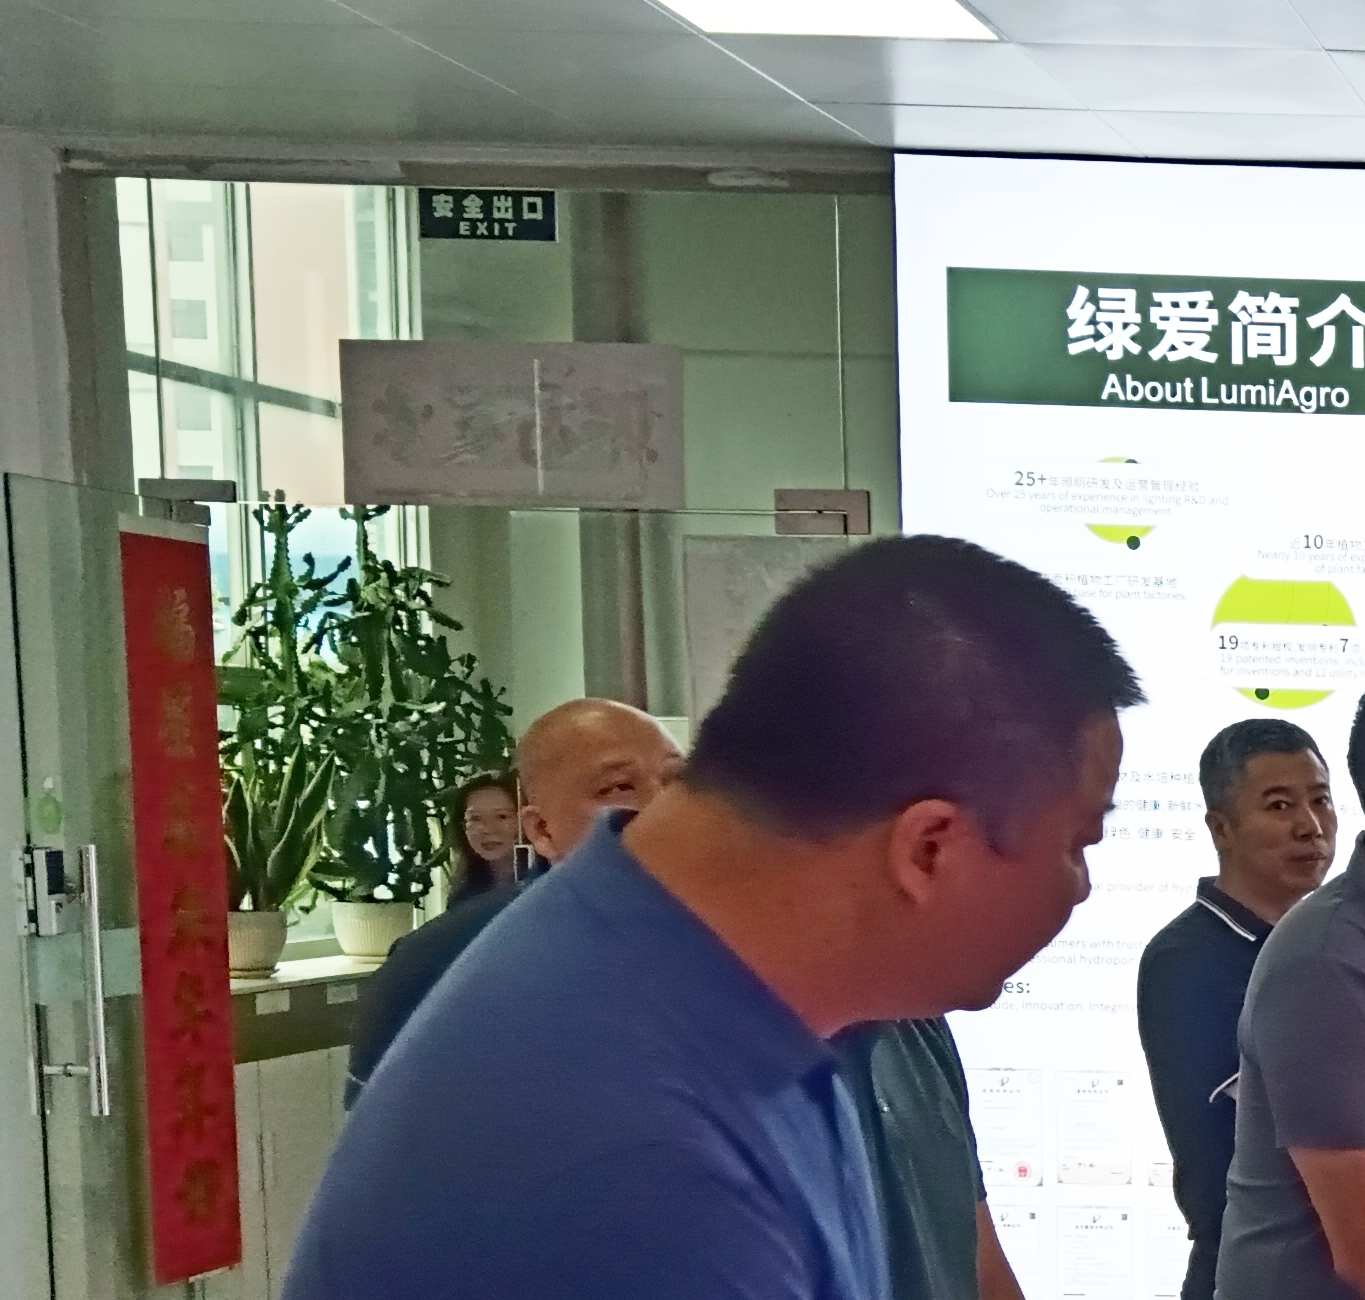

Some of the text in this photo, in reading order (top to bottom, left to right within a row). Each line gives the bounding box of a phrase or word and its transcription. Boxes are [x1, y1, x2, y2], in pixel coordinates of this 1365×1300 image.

[430, 194, 545, 220] 安全出口
[458, 221, 518, 237] EXIT
[1101, 373, 1350, 414] About LumiAgro
[986, 488, 1229, 505] Over 25 years of experience in lighting R&D and
[1039, 503, 1099, 515] operational
[1257, 549, 1291, 562] Nearly
[1293, 551, 1306, 560] 10
[1307, 552, 1335, 563] years
[1337, 551, 1348, 562] of
[1314, 563, 1325, 574] of
[1327, 563, 1354, 575] plant
[1073, 588, 1096, 598] base
[1099, 588, 1112, 598] for
[1115, 588, 1141, 601] plant
[1220, 653, 1232, 664] 19
[1236, 653, 1282, 665] patented
[1219, 666, 1234, 676] for
[1237, 666, 1289, 677] inventions
[1293, 667, 1312, 677] and
[1170, 828, 1196, 841] 安全
[1107, 882, 1154, 893] provider
[1157, 882, 1169, 892] of
[1089, 938, 1114, 949] with
[1089, 1001, 1136, 1014] Integrity
